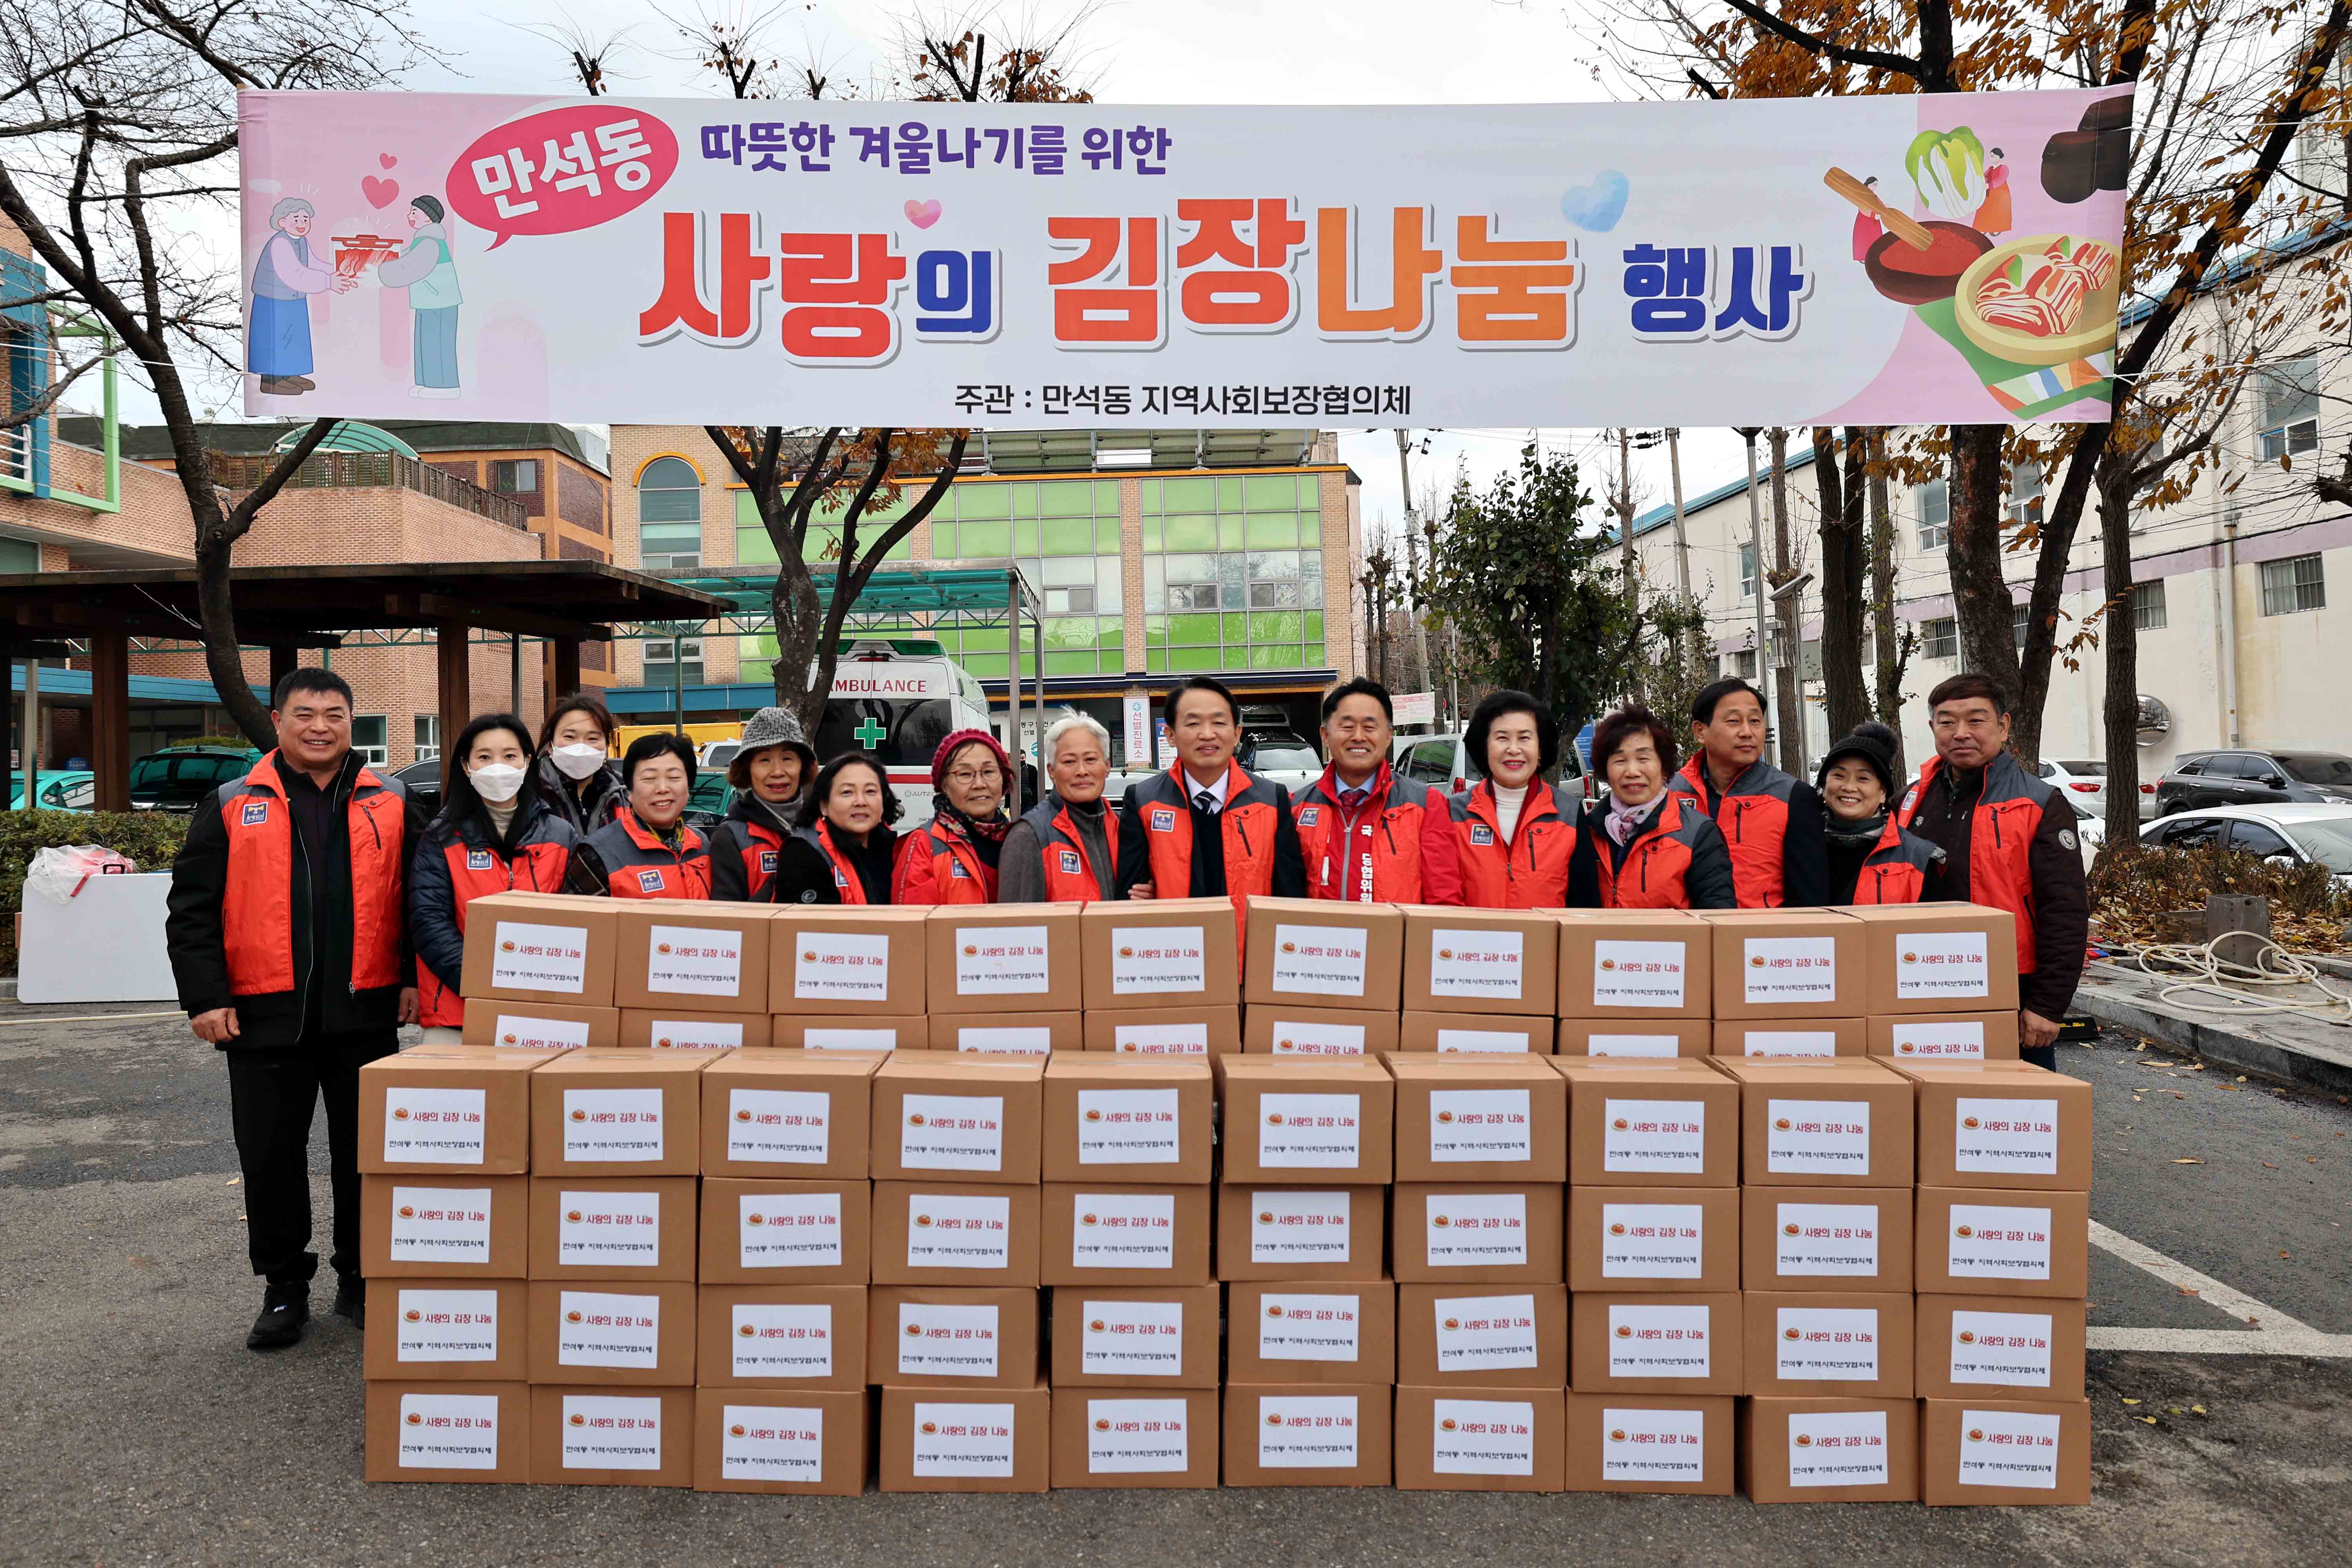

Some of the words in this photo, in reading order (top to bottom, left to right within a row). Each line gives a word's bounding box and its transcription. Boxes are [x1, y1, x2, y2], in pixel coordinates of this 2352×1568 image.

[471, 118, 652, 219] 만석동
[701, 122, 835, 171] 따뜻한
[849, 122, 1067, 175] 겨울나기를
[1081, 125, 1172, 175] 위한
[639, 212, 992, 358] 사랑의
[1048, 198, 1574, 341] 김장나눔
[1623, 243, 1804, 332] 행사
[955, 385, 1015, 414] 주관
[1043, 385, 1132, 414] 만석동
[1142, 385, 1410, 415] 지역사회보장협의체
[1132, 712, 1143, 758] 선별진료소
